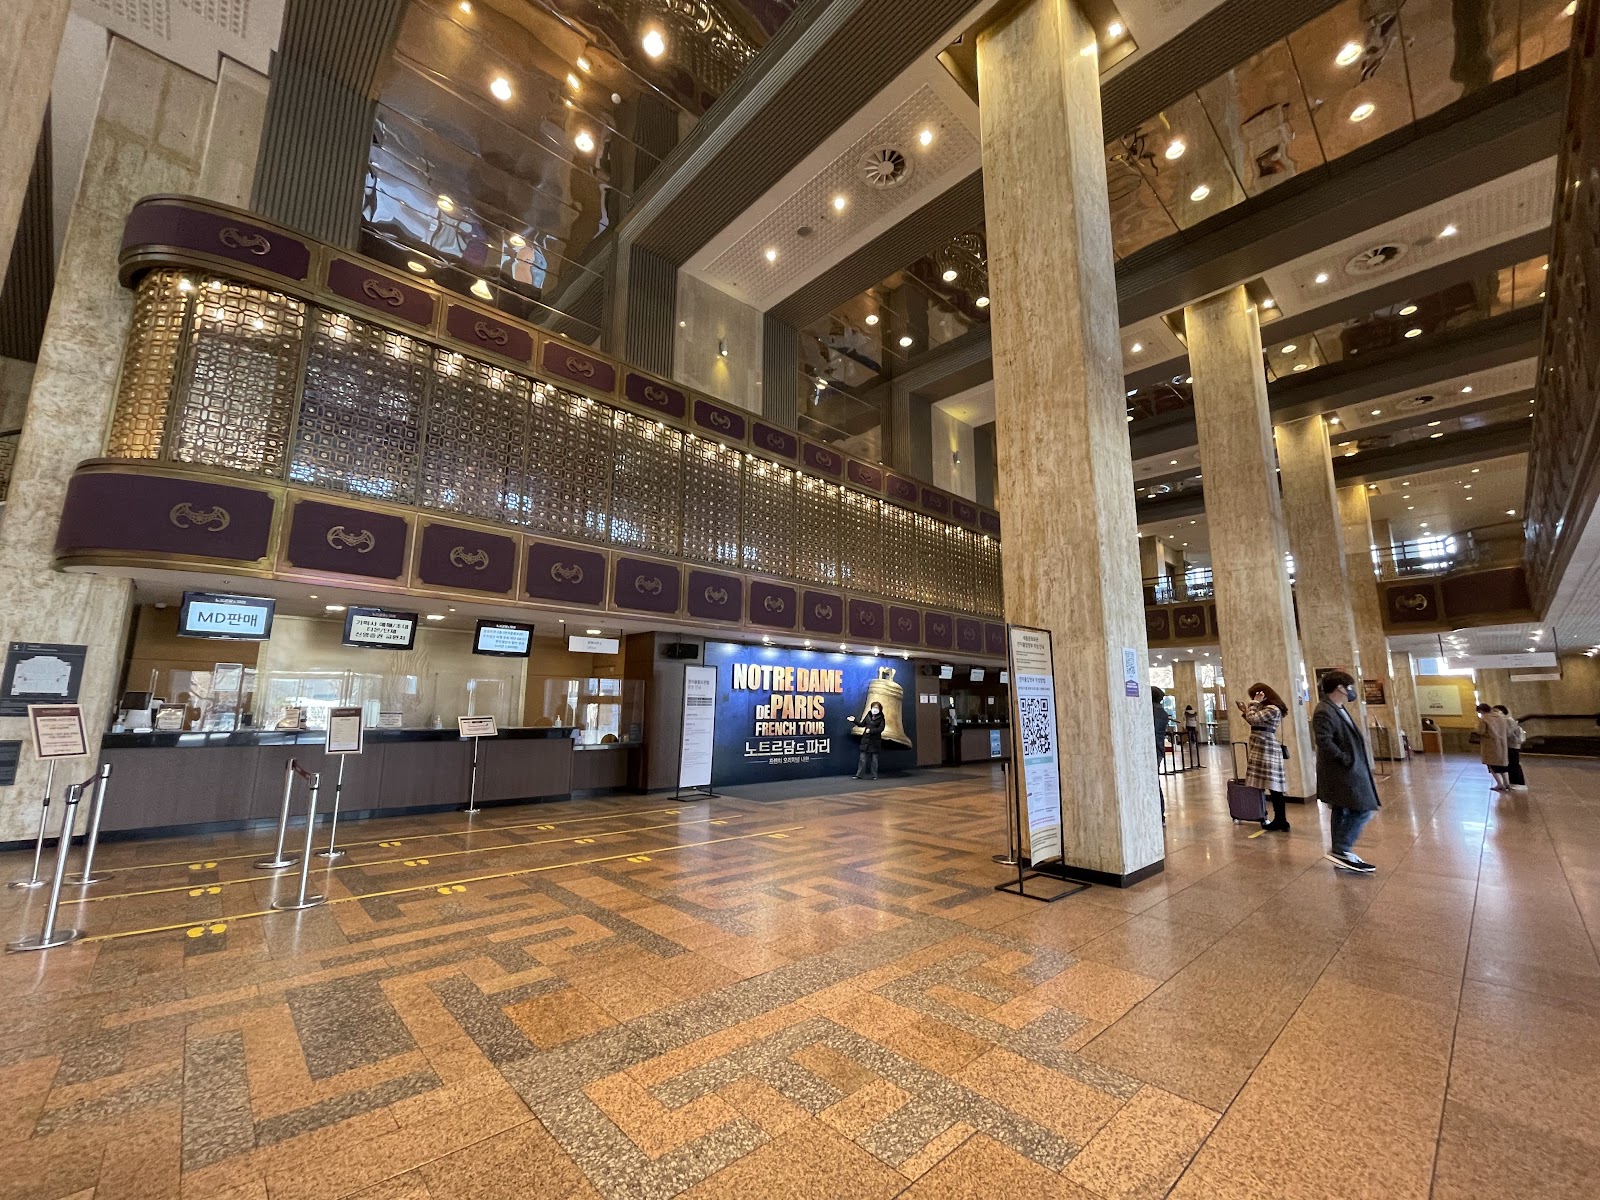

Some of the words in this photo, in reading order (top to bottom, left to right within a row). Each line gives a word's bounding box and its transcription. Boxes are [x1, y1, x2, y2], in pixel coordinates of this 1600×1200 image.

[197, 611, 258, 627] MD판매
[732, 663, 794, 692] NOTRE
[796, 667, 844, 693] DAME
[755, 704, 771, 720] DE
[770, 693, 825, 720] PARIS
[755, 721, 797, 736] FRENCH
[798, 720, 826, 736] TOUR
